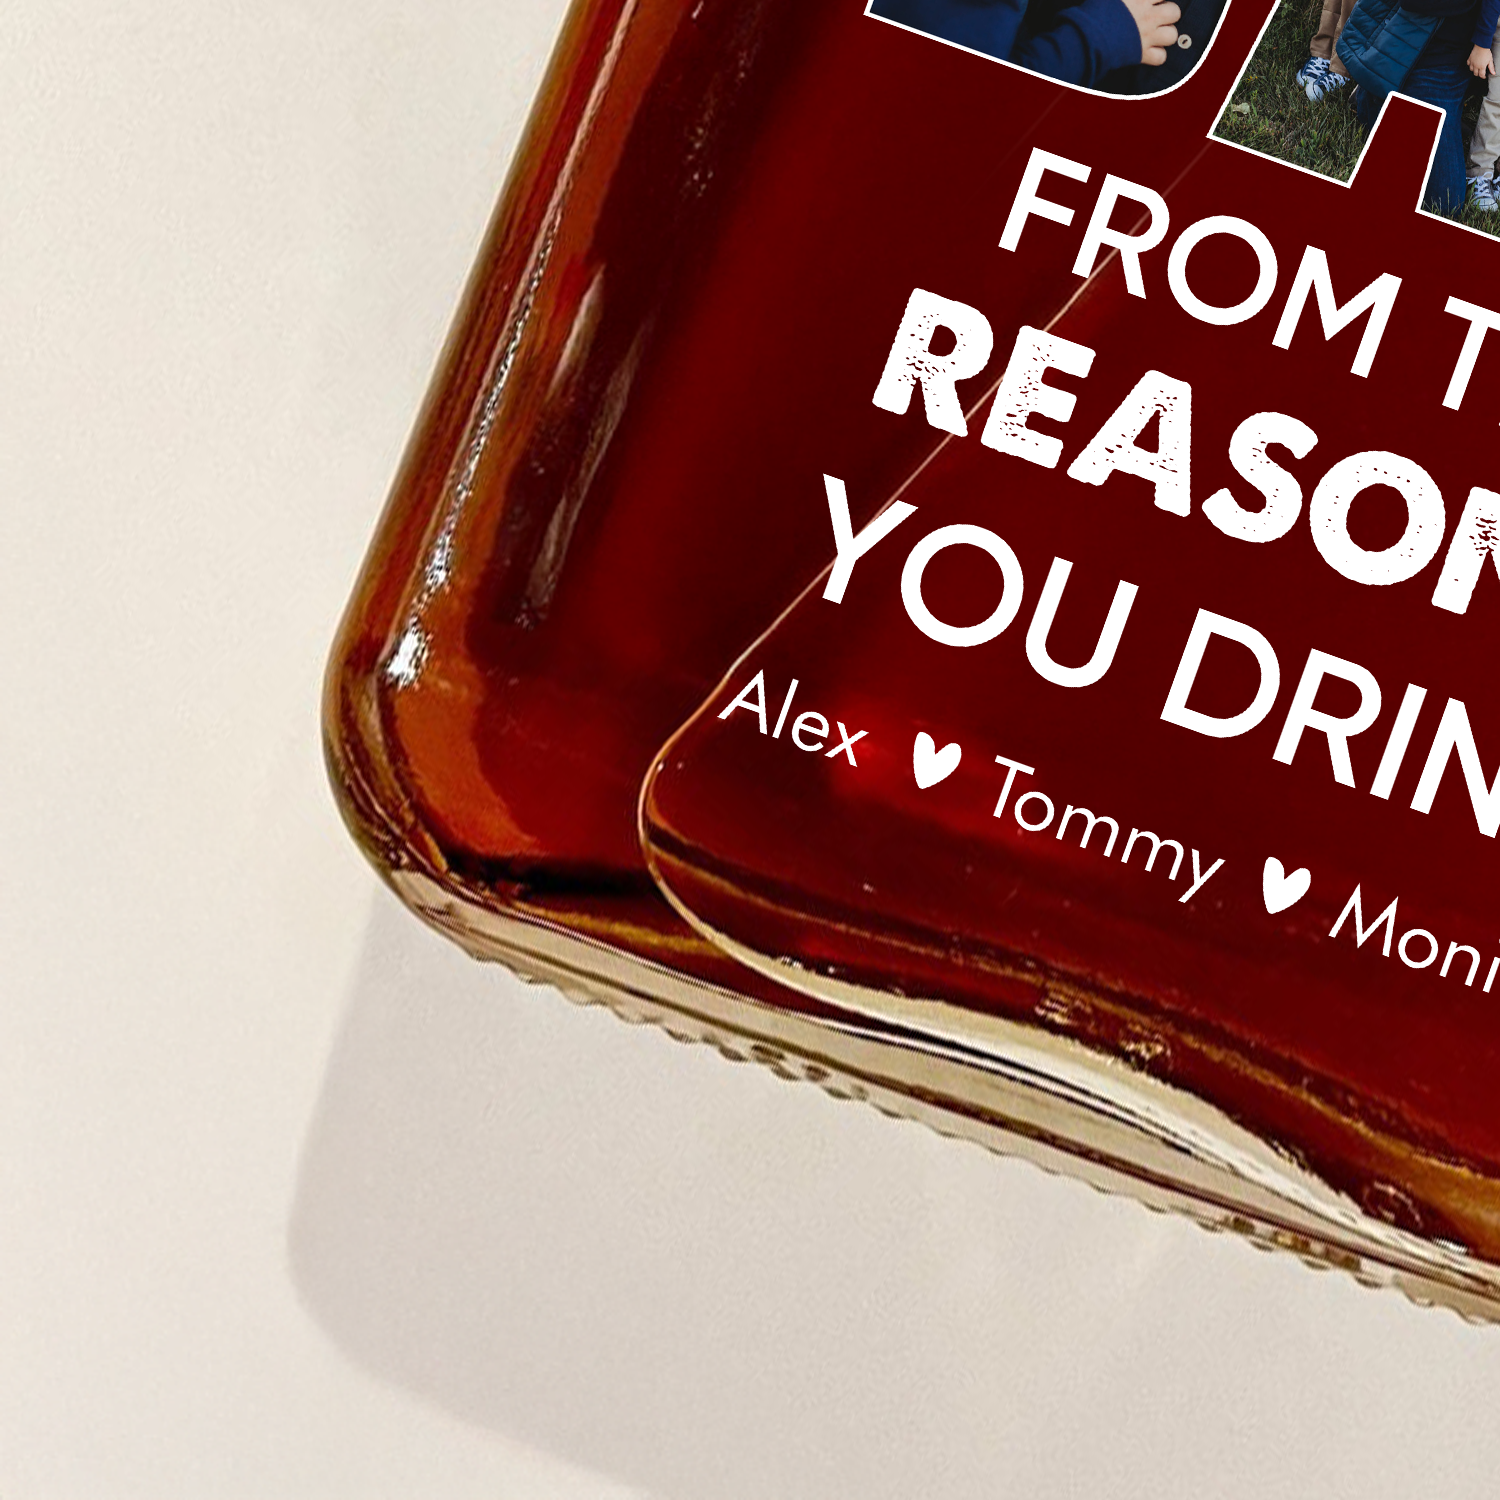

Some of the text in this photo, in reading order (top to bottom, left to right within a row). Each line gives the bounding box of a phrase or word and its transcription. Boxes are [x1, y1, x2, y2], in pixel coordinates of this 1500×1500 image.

[999, 147, 1402, 378] FROM
[823, 474, 1139, 687] YOU
[717, 668, 868, 769] Alex
[993, 755, 1225, 903] Tommy
